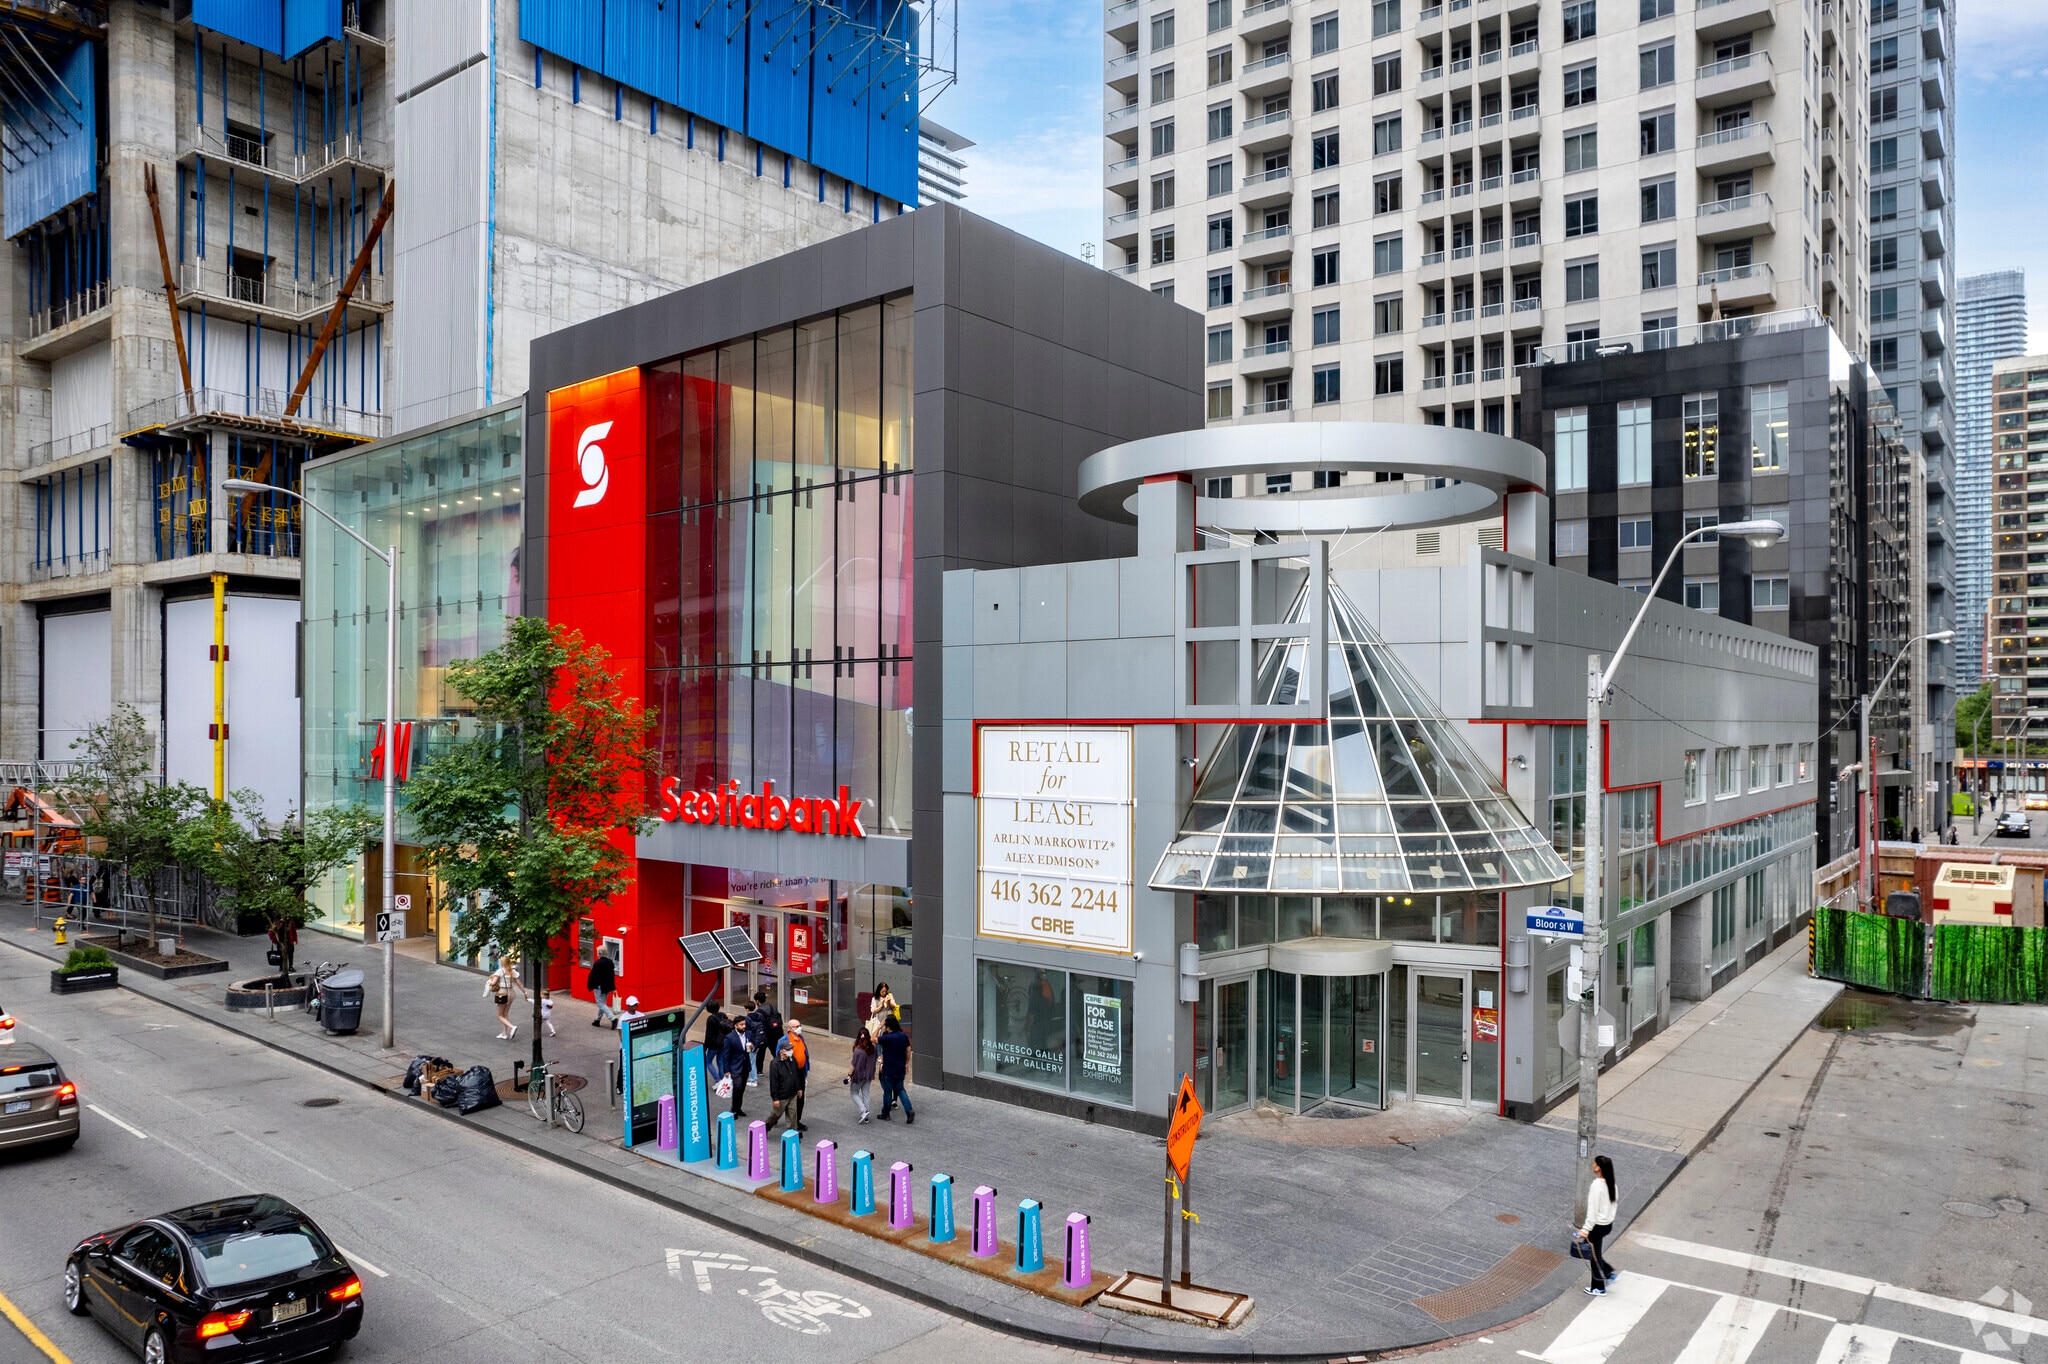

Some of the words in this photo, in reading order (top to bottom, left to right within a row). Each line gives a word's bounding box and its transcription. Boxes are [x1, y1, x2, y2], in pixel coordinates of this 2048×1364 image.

[1009, 741, 1100, 764] RETAIL
[1036, 766, 1066, 794] for
[660, 776, 866, 837] Scotiabank
[1013, 801, 1094, 826] LEASE
[993, 833, 1031, 846] ARLIN
[1005, 852, 1034, 864] ALEX
[760, 880, 782, 889] richer
[785, 878, 802, 886] than
[991, 879, 1021, 902] 416
[1028, 882, 1062, 907] 362
[1071, 887, 1117, 913] 2244
[1031, 916, 1074, 935] CBRE
[1536, 918, 1557, 929] Bloor
[1567, 922, 1574, 931] W
[1087, 1006, 1105, 1018] FOR
[1088, 1017, 1113, 1030] LEASE
[982, 1039, 1032, 1055] FRANCESCO
[983, 1051, 1001, 1061] FINE
[1004, 1055, 1020, 1065] ART
[1024, 1059, 1063, 1073] GALLERY
[1083, 1061, 1096, 1070] SEA
[1098, 1065, 1121, 1075] BEARS
[1083, 1070, 1121, 1084] EXHIBITION
[689, 1067, 698, 1120] NORDSTROM
[692, 1121, 701, 1143] rack
[1169, 1111, 1199, 1148] CONSTRUCTION
